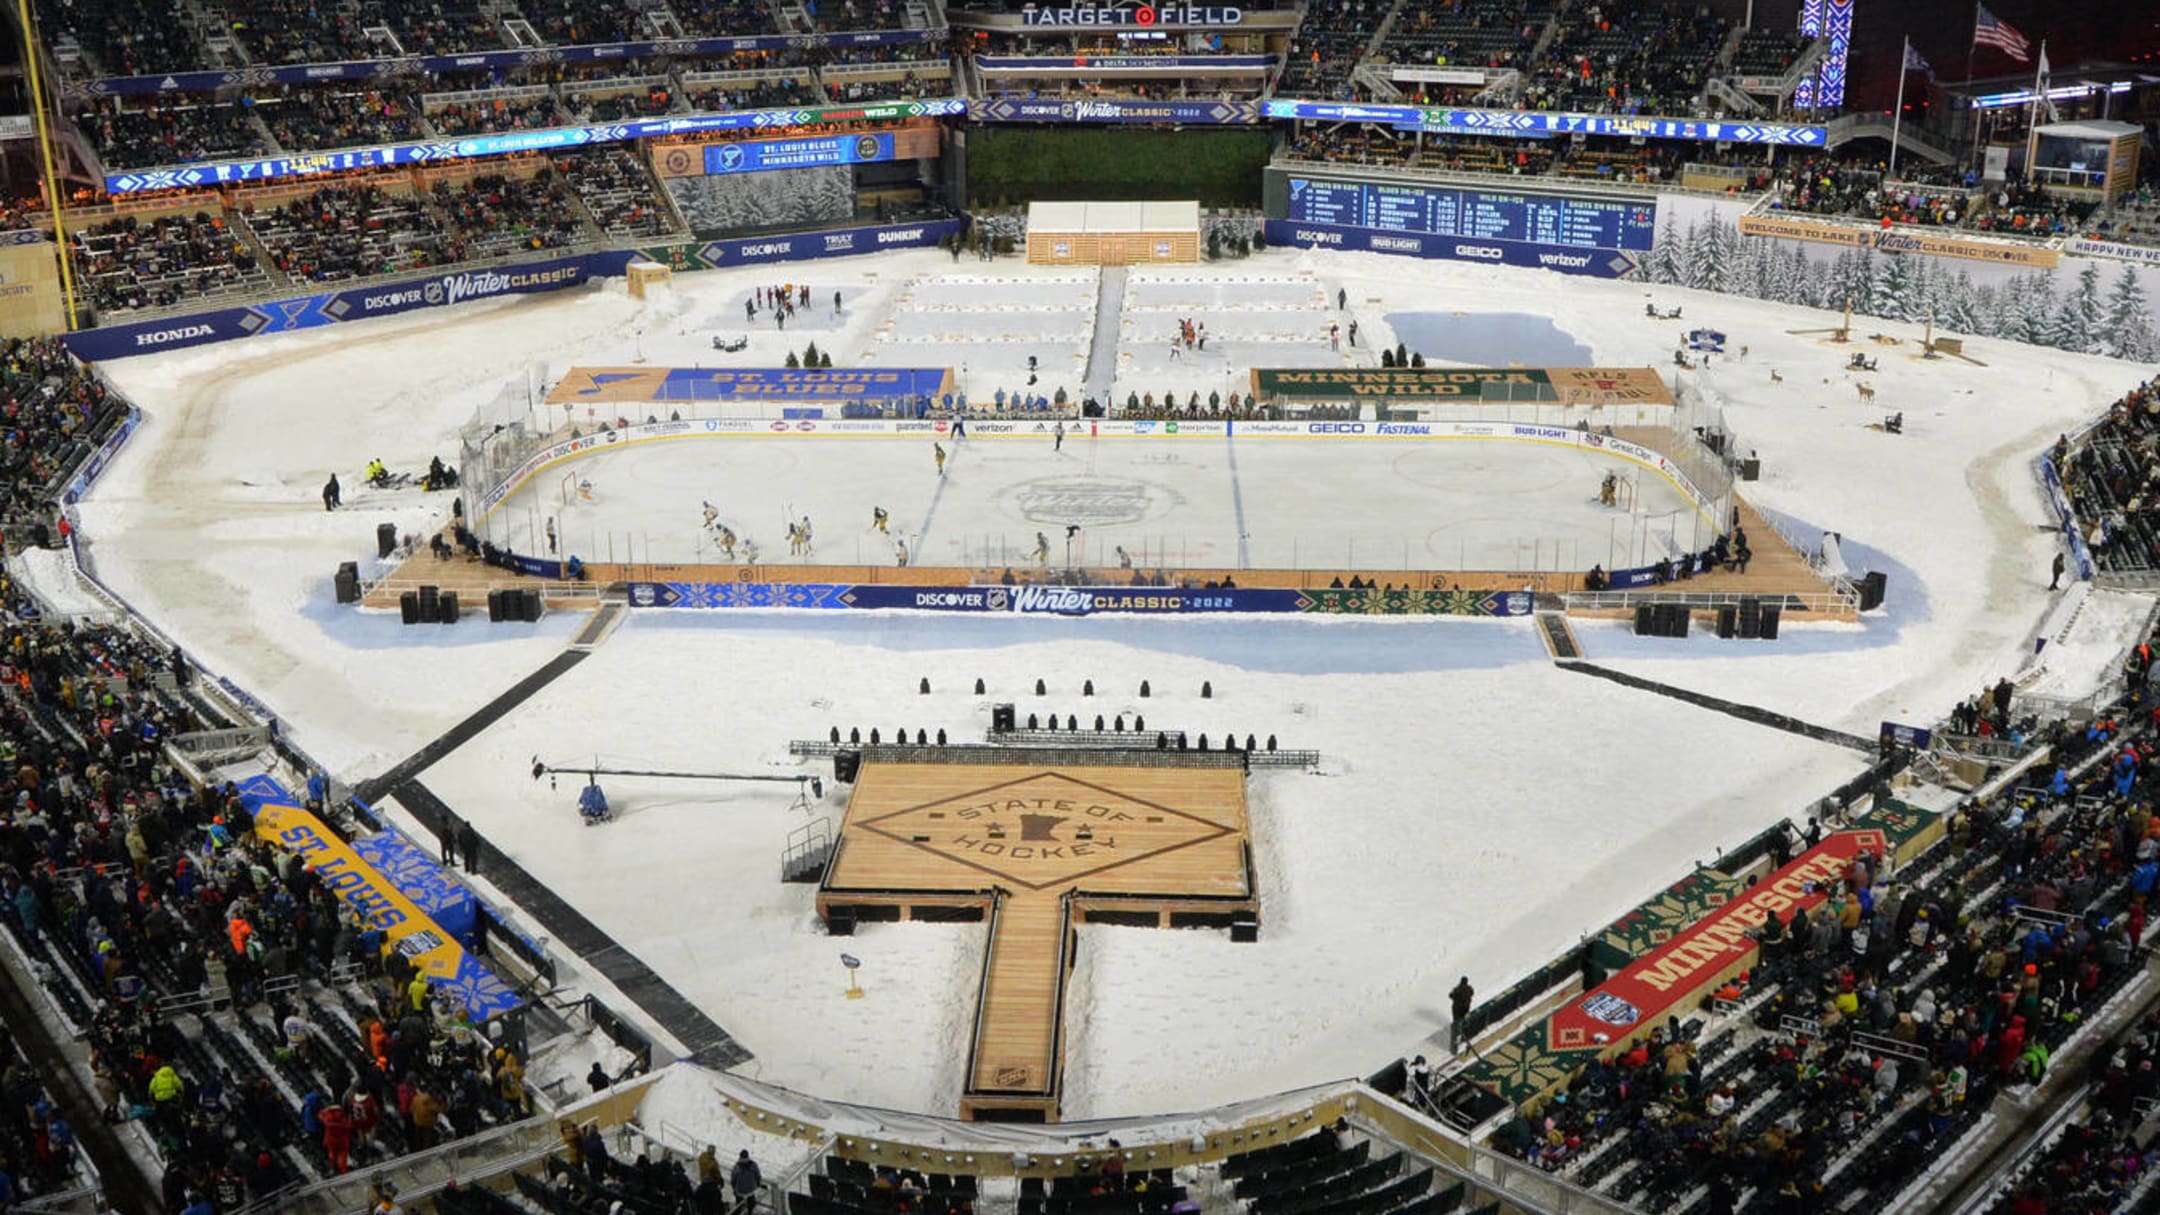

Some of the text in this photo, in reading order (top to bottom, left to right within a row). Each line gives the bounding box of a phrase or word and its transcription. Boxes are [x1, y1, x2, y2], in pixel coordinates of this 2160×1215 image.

[1023, 8, 1242, 25] TARGET FIELD
[864, 107, 898, 117] WILD
[1021, 106, 1060, 115] DISCOVER
[1075, 101, 1121, 120] Winter
[1122, 107, 1172, 117] CLASSIC
[780, 143, 806, 152] LOUIS
[809, 141, 838, 150] BLUES
[763, 154, 815, 165] MINNESOTA
[878, 229, 924, 243] DUNKIN'
[1296, 230, 1343, 244] DISCOVER
[1744, 222, 2028, 262] WELCOME TO LAKE Winter CLASSIC DISCOVER
[741, 243, 791, 256] DISCOVER
[1371, 238, 1419, 250] BUD LIGHT
[2075, 242, 2114, 254] HAPPY
[2117, 247, 2143, 258] NEW
[1455, 245, 1503, 258] GEICO
[1540, 252, 1585, 267] verizon
[364, 267, 577, 310] DISCOVER Winter CLASSIC
[135, 324, 215, 346] HONDA
[711, 372, 899, 384] ST. LOUIS
[1276, 373, 1537, 384] MINNESOTA
[732, 383, 866, 395] BLUES
[1351, 384, 1461, 396] WILD
[974, 423, 1012, 432] verizon
[1308, 423, 1366, 433] GEICO
[1375, 423, 1431, 435] FASTENAL
[1514, 426, 1568, 439] BUD LIGHT
[553, 437, 596, 458] DISCOVER
[916, 586, 1234, 612] DISCOVER Winter CLASSIC 2022
[957, 798, 1136, 823] STATE OF
[953, 835, 1116, 860] HOCKEY
[280, 824, 408, 930] ST. LOUIS
[1634, 852, 1849, 993] MINNESOTA
